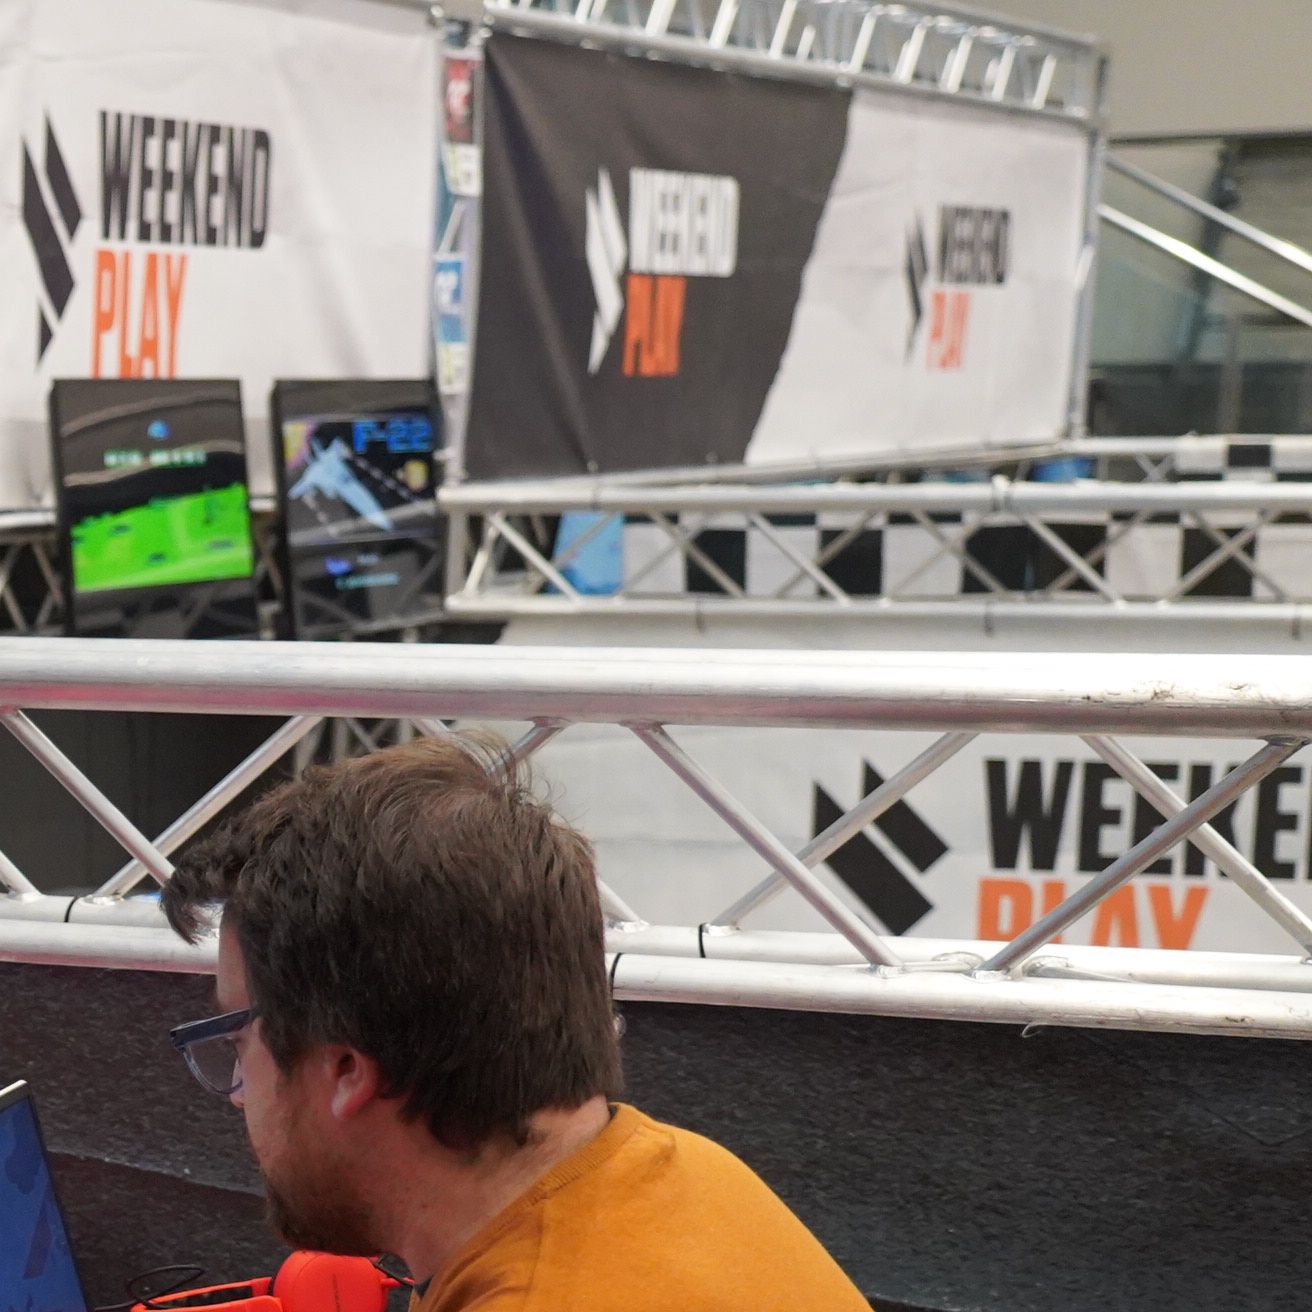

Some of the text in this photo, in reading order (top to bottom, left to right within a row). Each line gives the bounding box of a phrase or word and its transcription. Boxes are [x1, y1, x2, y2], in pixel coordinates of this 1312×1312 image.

[99, 109, 272, 250] WEEKEND
[91, 249, 189, 380] PLAY
[984, 757, 1312, 881] WEEKE
